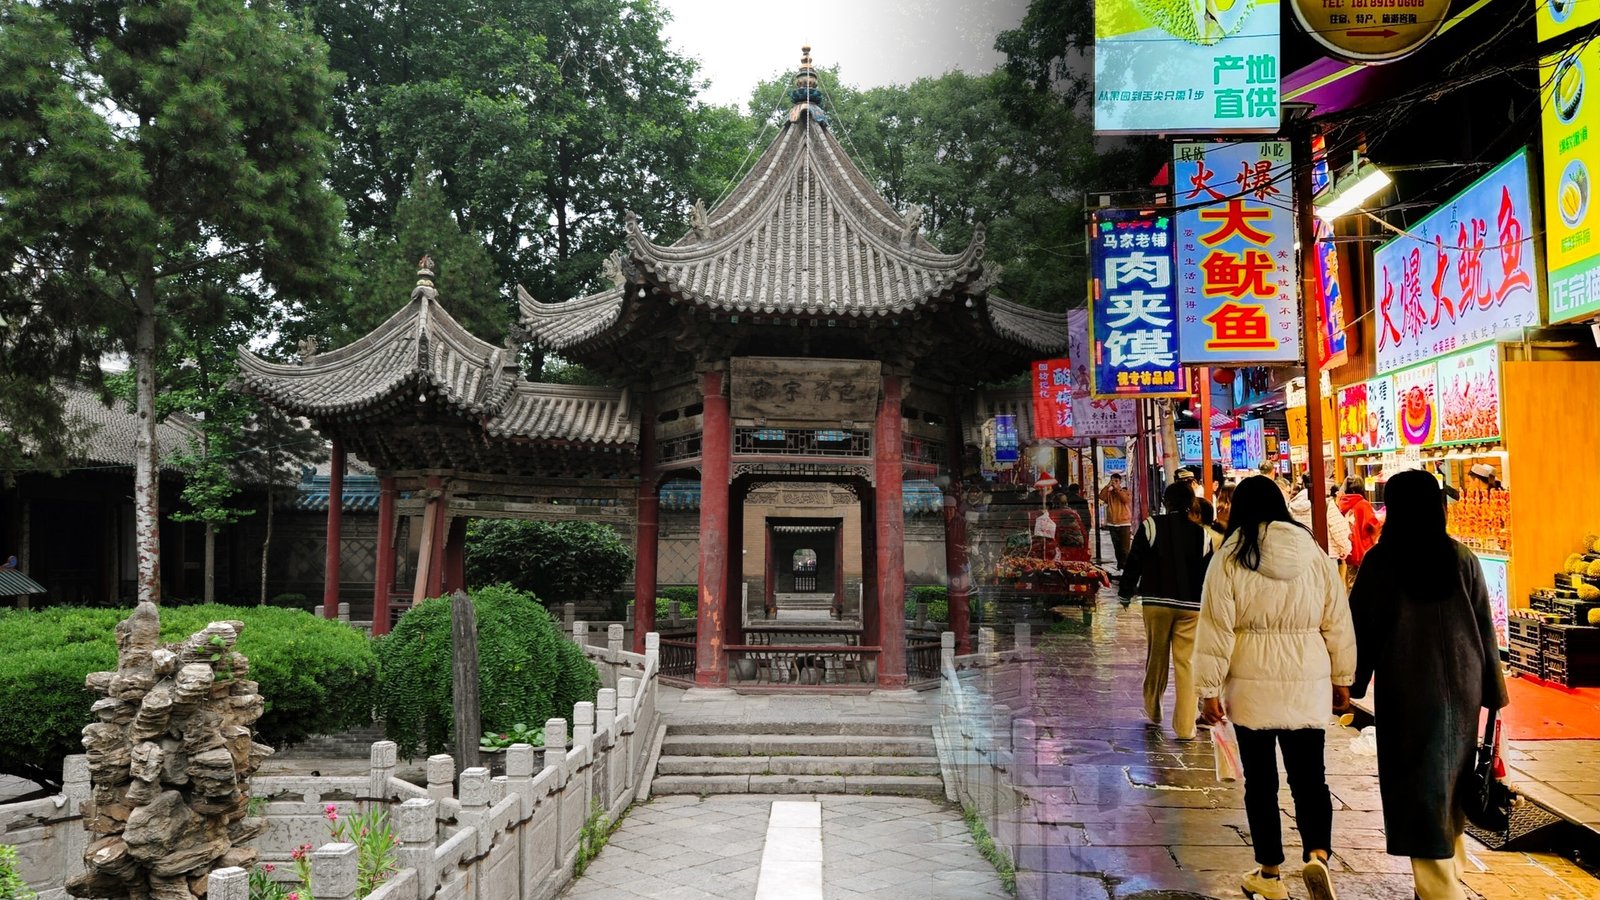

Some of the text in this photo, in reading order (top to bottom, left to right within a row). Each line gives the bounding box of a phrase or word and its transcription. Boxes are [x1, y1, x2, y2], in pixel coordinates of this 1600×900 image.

[1322, 0, 1345, 8] TEL:
[1213, 54, 1277, 85] 产地
[1098, 88, 1205, 102] 从果园到舌尖只需1步
[1213, 87, 1277, 119] 直供
[1181, 143, 1284, 161] 民族 小吃
[1185, 160, 1280, 201] 火爆
[1103, 232, 1168, 249] 马家老铺
[1200, 199, 1278, 350] 大鱿鱼
[1378, 185, 1532, 351] 火爆大鱿鱼
[1104, 252, 1176, 368] 肉夹馍
[1276, 250, 1293, 344] 美味鱿鱼不可少
[1053, 368, 1073, 428] 酸梅汤
